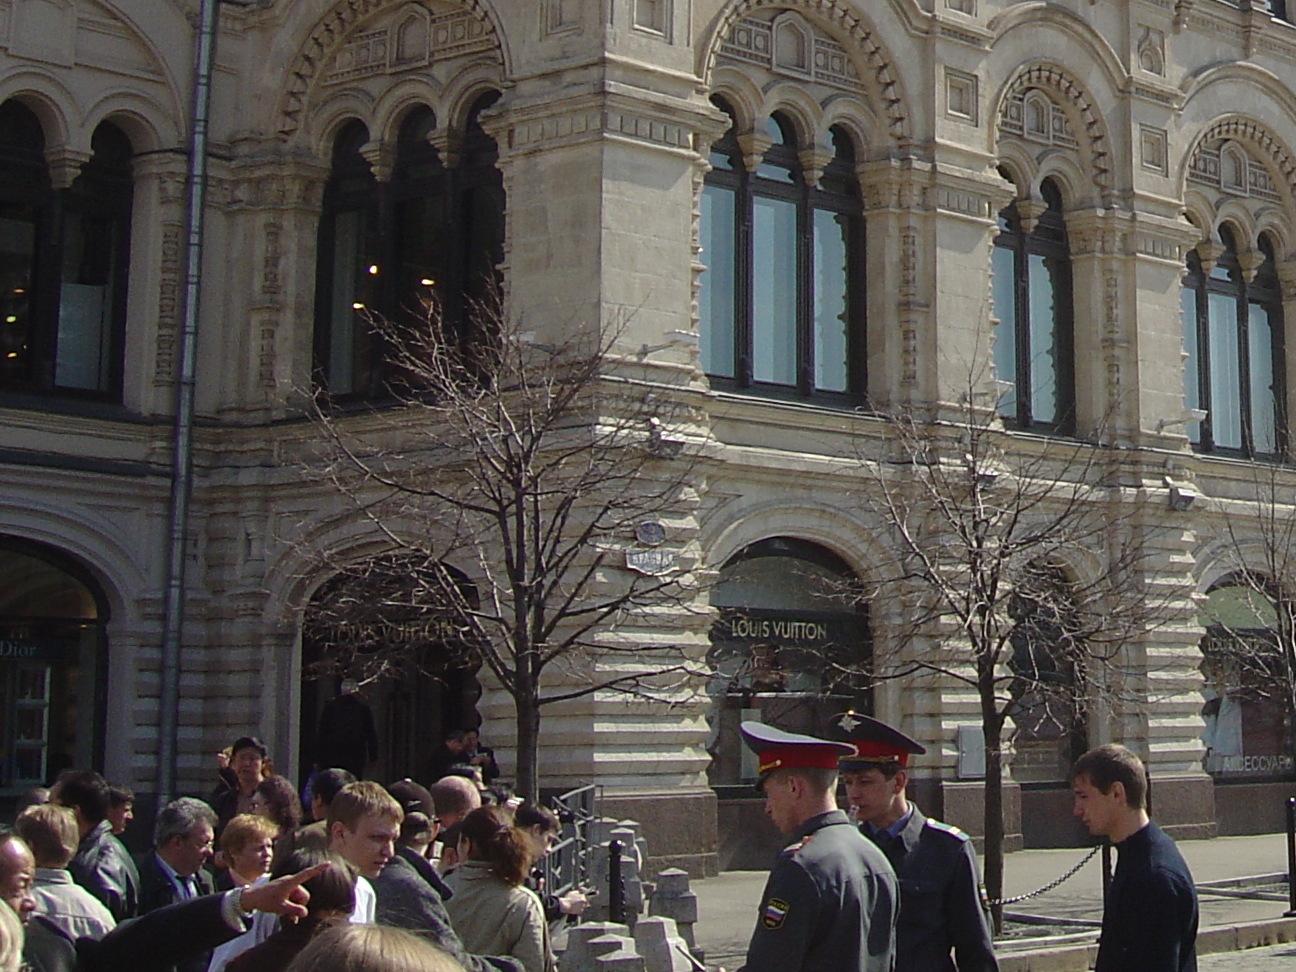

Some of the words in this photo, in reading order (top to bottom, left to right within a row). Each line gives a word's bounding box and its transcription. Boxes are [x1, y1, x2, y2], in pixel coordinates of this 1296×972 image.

[732, 620, 769, 638] LOUIS
[772, 621, 827, 640] VUITTON
[0, 639, 36, 657] Dior
